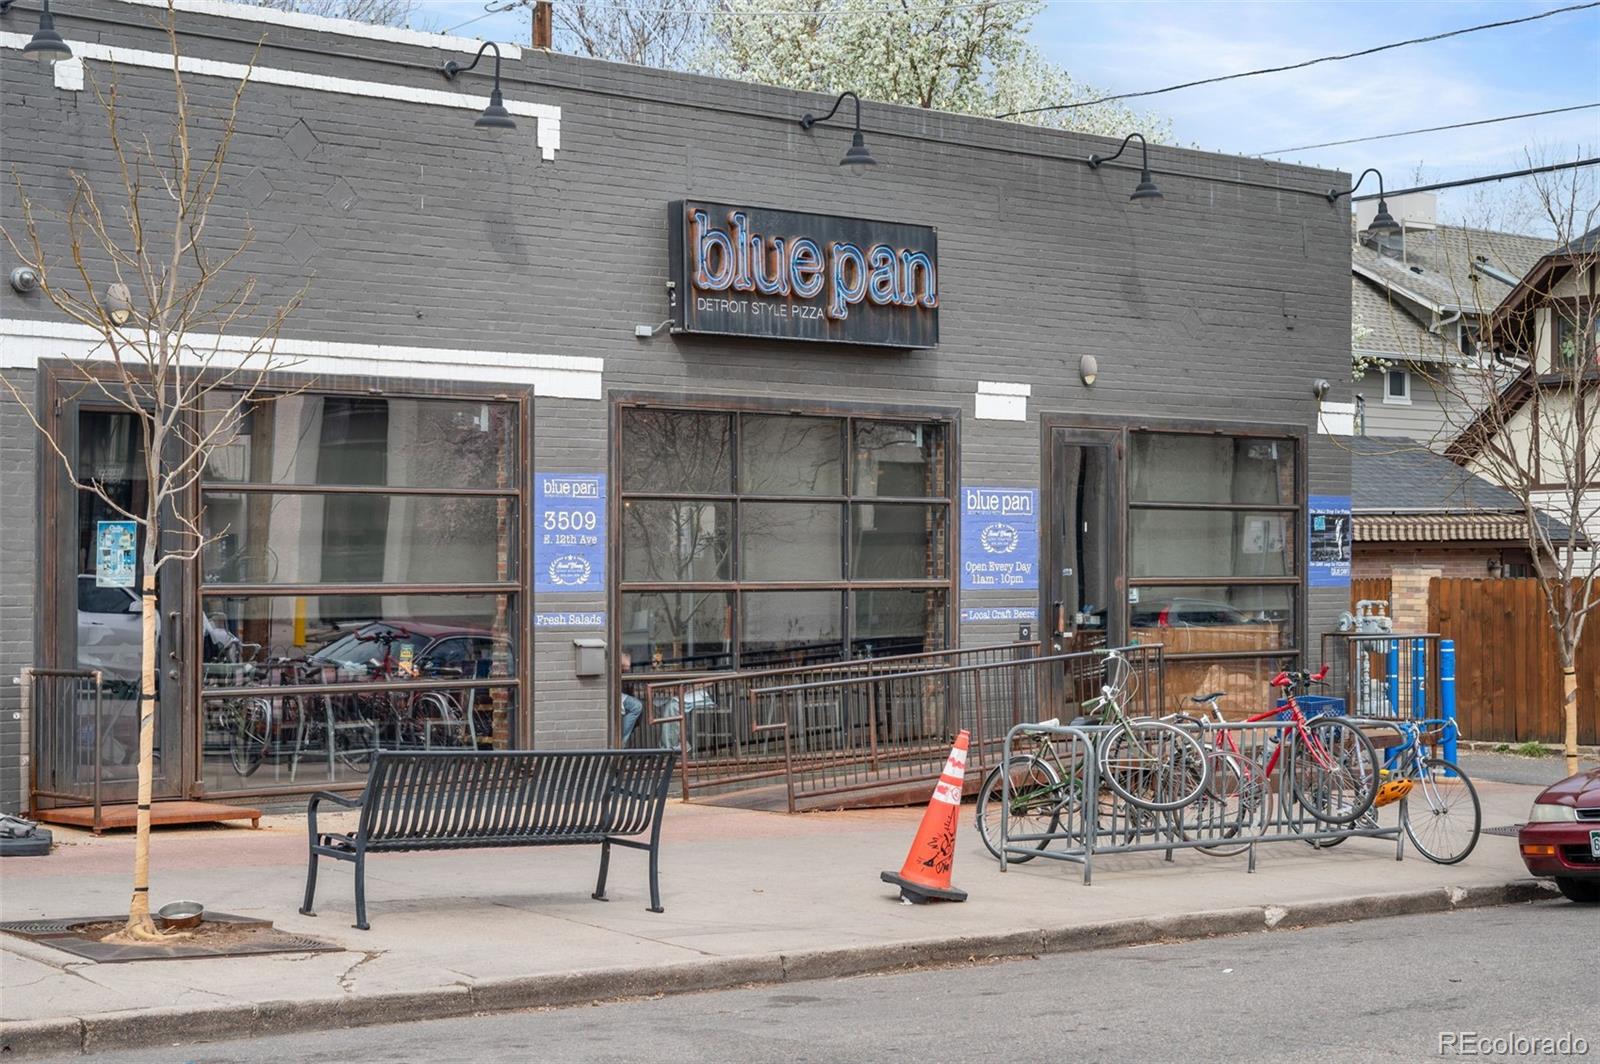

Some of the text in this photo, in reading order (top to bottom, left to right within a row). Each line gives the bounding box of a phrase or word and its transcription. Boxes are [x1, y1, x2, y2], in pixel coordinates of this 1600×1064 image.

[688, 208, 939, 321] blue pan
[697, 297, 825, 320] DETROIT STYLE PIZZA
[543, 478, 597, 498] blue pan
[967, 489, 1030, 516] blue pan
[543, 511, 597, 531] 3509
[543, 534, 598, 545] E. 12th Ave
[965, 561, 1032, 575] Open Every Day
[536, 613, 602, 626] Fresh Salads
[968, 609, 1036, 620] Local Craft Beers
